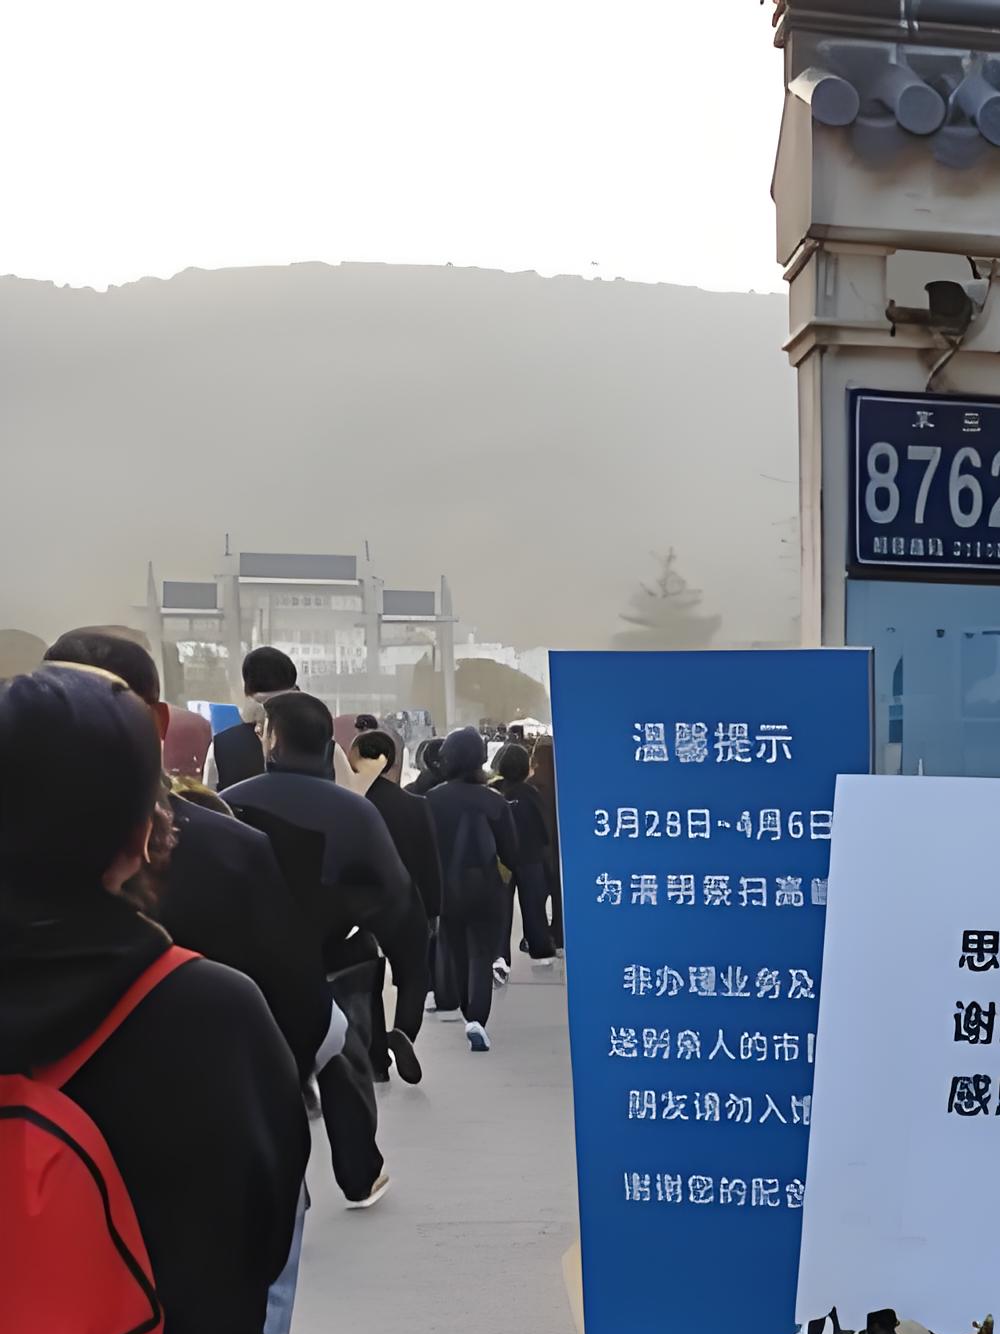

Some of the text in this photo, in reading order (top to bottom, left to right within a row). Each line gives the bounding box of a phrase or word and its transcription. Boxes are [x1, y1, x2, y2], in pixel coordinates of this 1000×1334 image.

[632, 722, 793, 764] 温馨提示
[608, 1026, 816, 1064] 送别亲人的市
